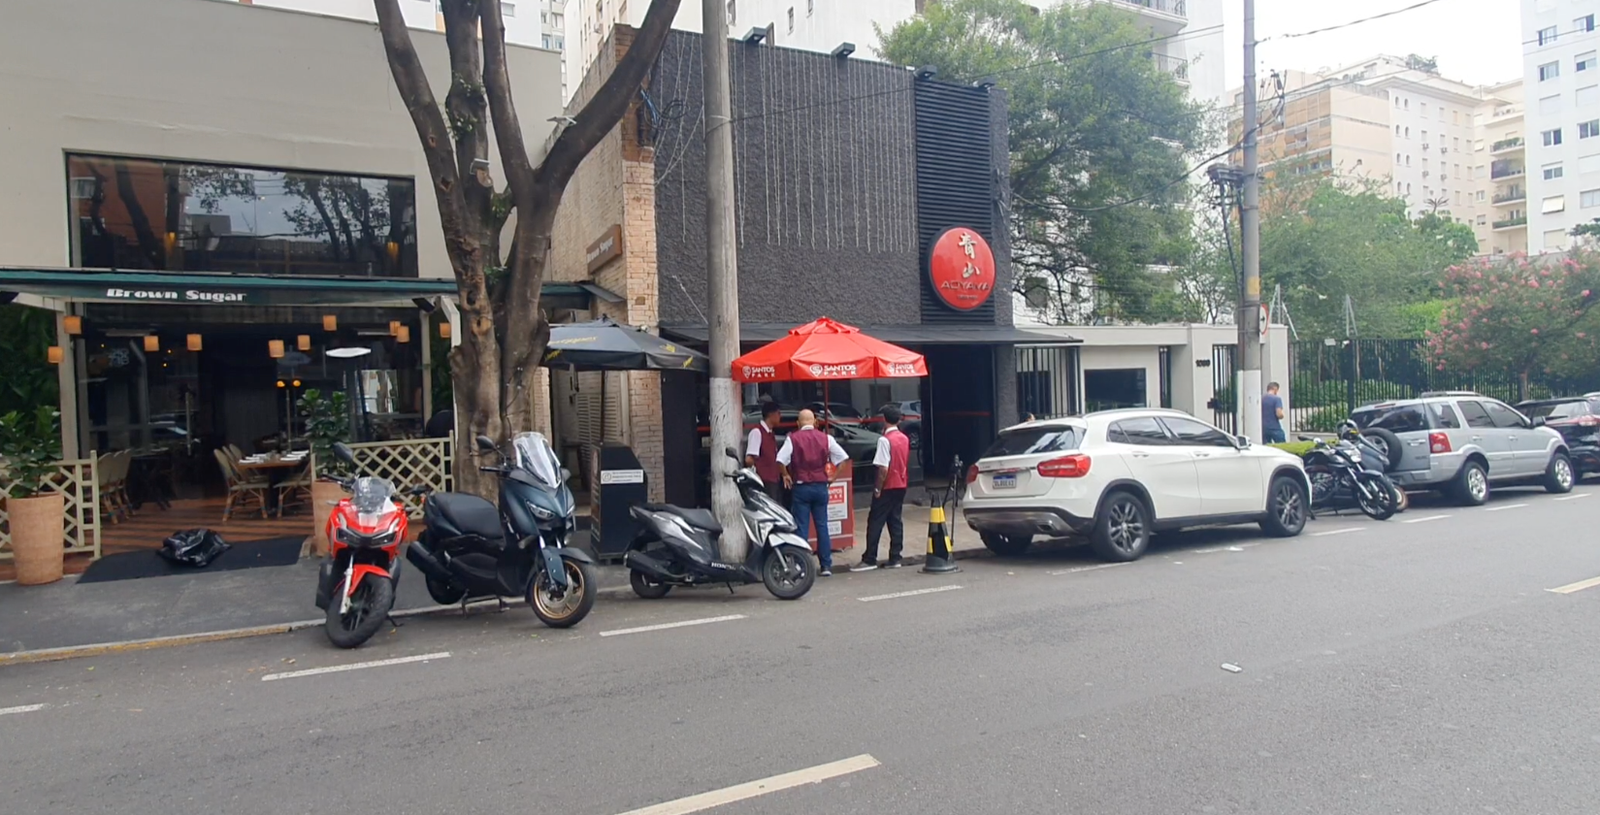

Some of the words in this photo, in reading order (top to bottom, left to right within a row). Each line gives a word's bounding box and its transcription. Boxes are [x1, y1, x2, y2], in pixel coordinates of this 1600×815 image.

[941, 280, 990, 291] AOYAMA
[106, 288, 178, 299] Brown
[185, 290, 247, 302] Sugar
[823, 364, 857, 372] SANTOS
